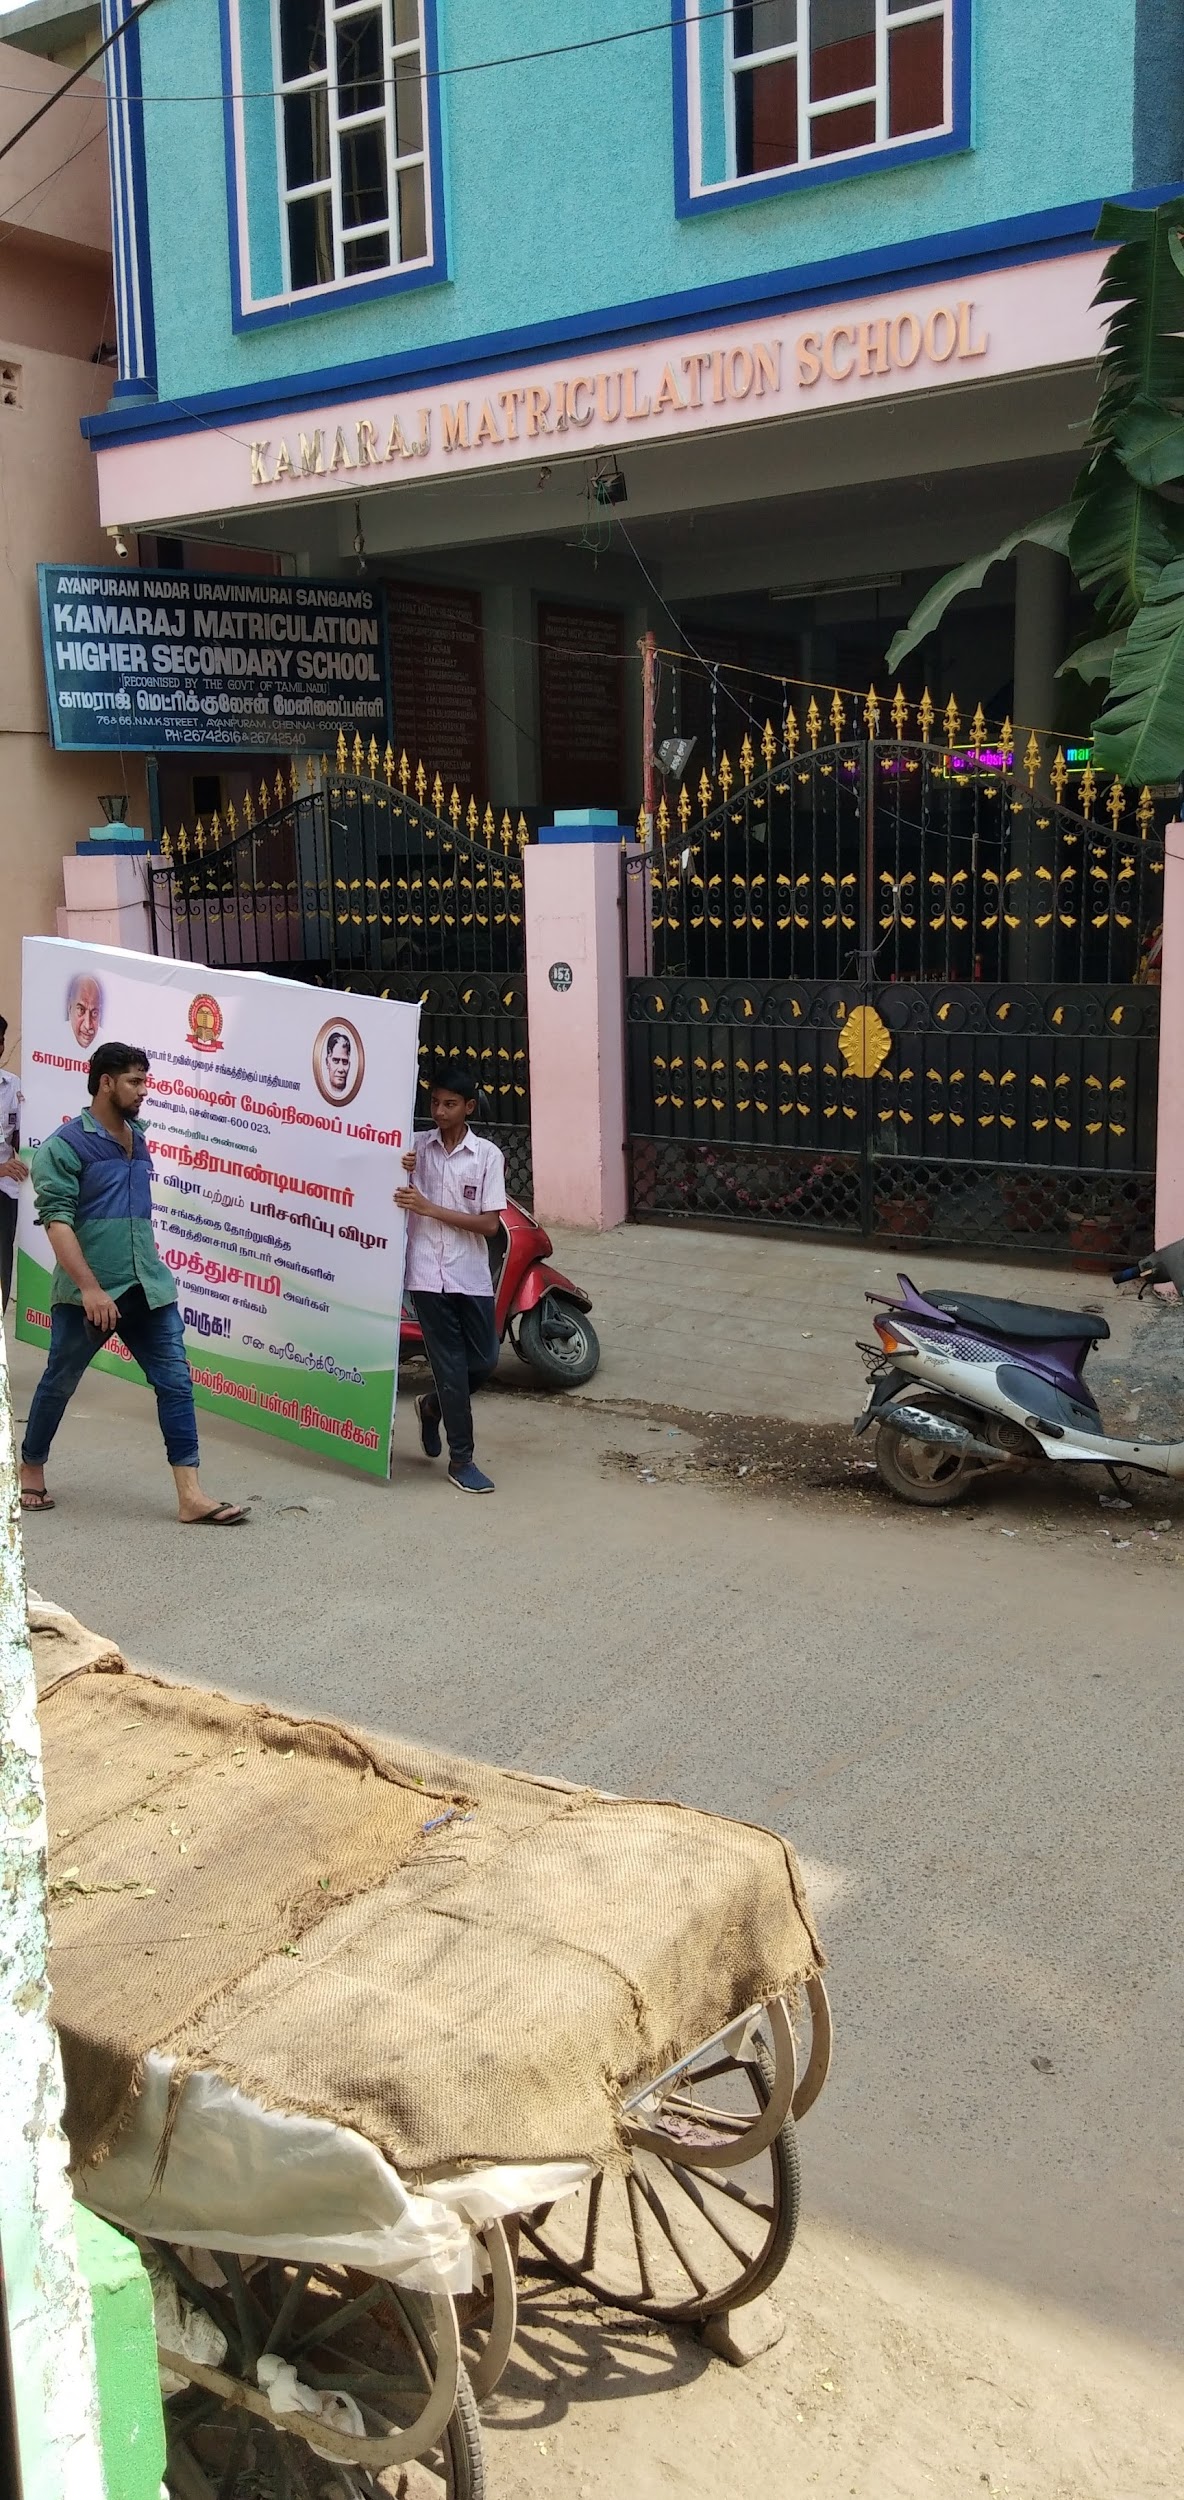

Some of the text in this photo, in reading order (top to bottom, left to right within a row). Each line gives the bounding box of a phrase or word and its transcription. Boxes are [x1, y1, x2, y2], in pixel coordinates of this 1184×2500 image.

[249, 302, 989, 485] KAMARAJ MATRICULATION SCHOOL
[56, 576, 373, 610] AYANPURAM NADAR URAVINMURAI SANGAM'S
[53, 603, 379, 646] KAMARAJ MATRICULATION
[55, 641, 381, 682] HIGHER SECONDARY SCHOOL
[58, 688, 132, 712] காமராஜ்
[184, 678, 199, 689] BY
[202, 678, 223, 690] THE
[227, 679, 256, 691] GOVT
[259, 680, 274, 692] OF
[553, 967, 570, 982] 153
[144, 1073, 237, 1108] க்குலேஷன்
[240, 1094, 343, 1134] மேல்நிலைப்
[346, 1123, 402, 1148] பள்ளி
[163, 1175, 201, 1195] விழா
[202, 1188, 245, 1208] மற்றும்
[250, 1200, 335, 1239] பரிசளிப்பு
[338, 1225, 389, 1250] விழா
[239, 1245, 272, 1264] நாடார்
[273, 1256, 336, 1283] அவர்களின்
[232, 1297, 268, 1315] சங்கம்
[282, 1290, 331, 1314] அவர்கள்
[258, 1391, 299, 1421] பள்ளி
[299, 1402, 381, 1451] நிர்வாகிகள்
